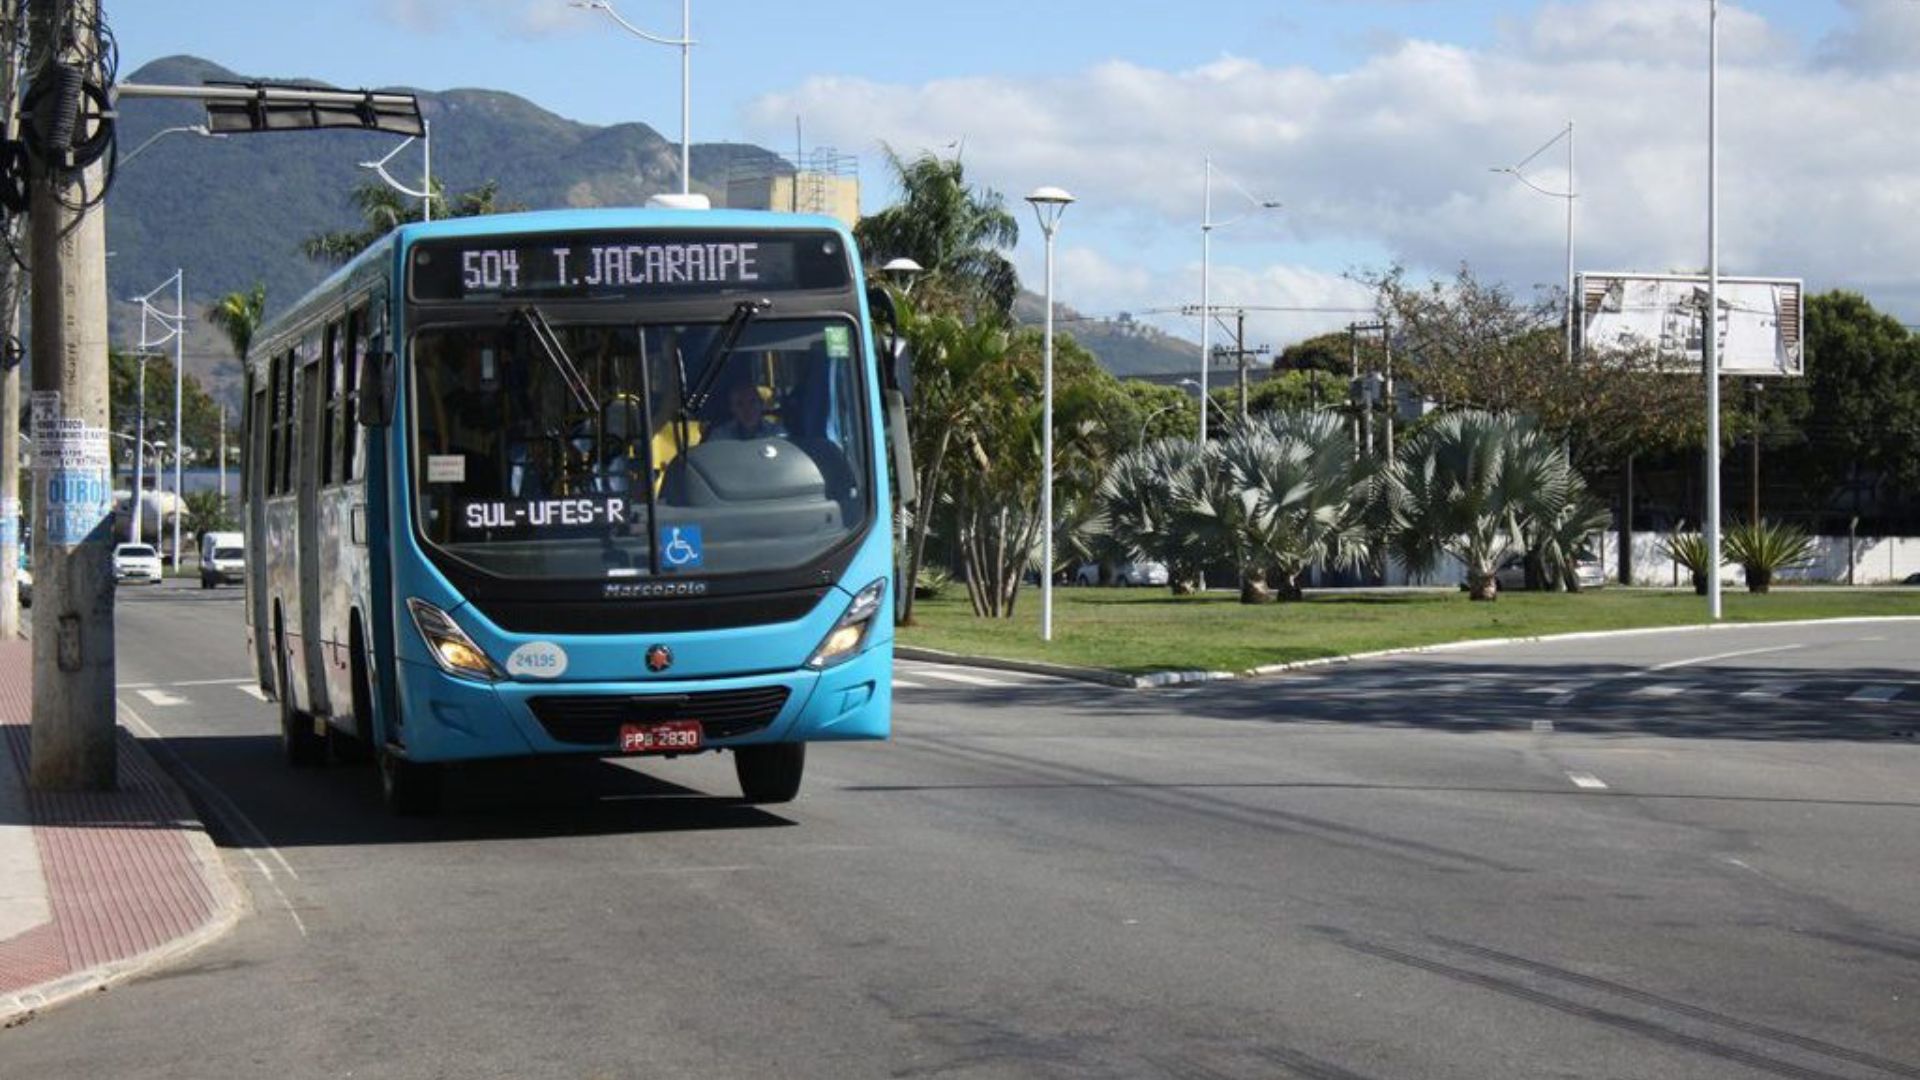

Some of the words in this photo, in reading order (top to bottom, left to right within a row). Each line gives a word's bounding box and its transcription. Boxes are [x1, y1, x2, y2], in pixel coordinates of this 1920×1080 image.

[462, 250, 520, 288] 504
[552, 243, 759, 287] T.JACARAIPE
[466, 498, 624, 528] SUL-UFES-R
[604, 581, 707, 597] Marcopolo
[515, 653, 557, 668] 24195
